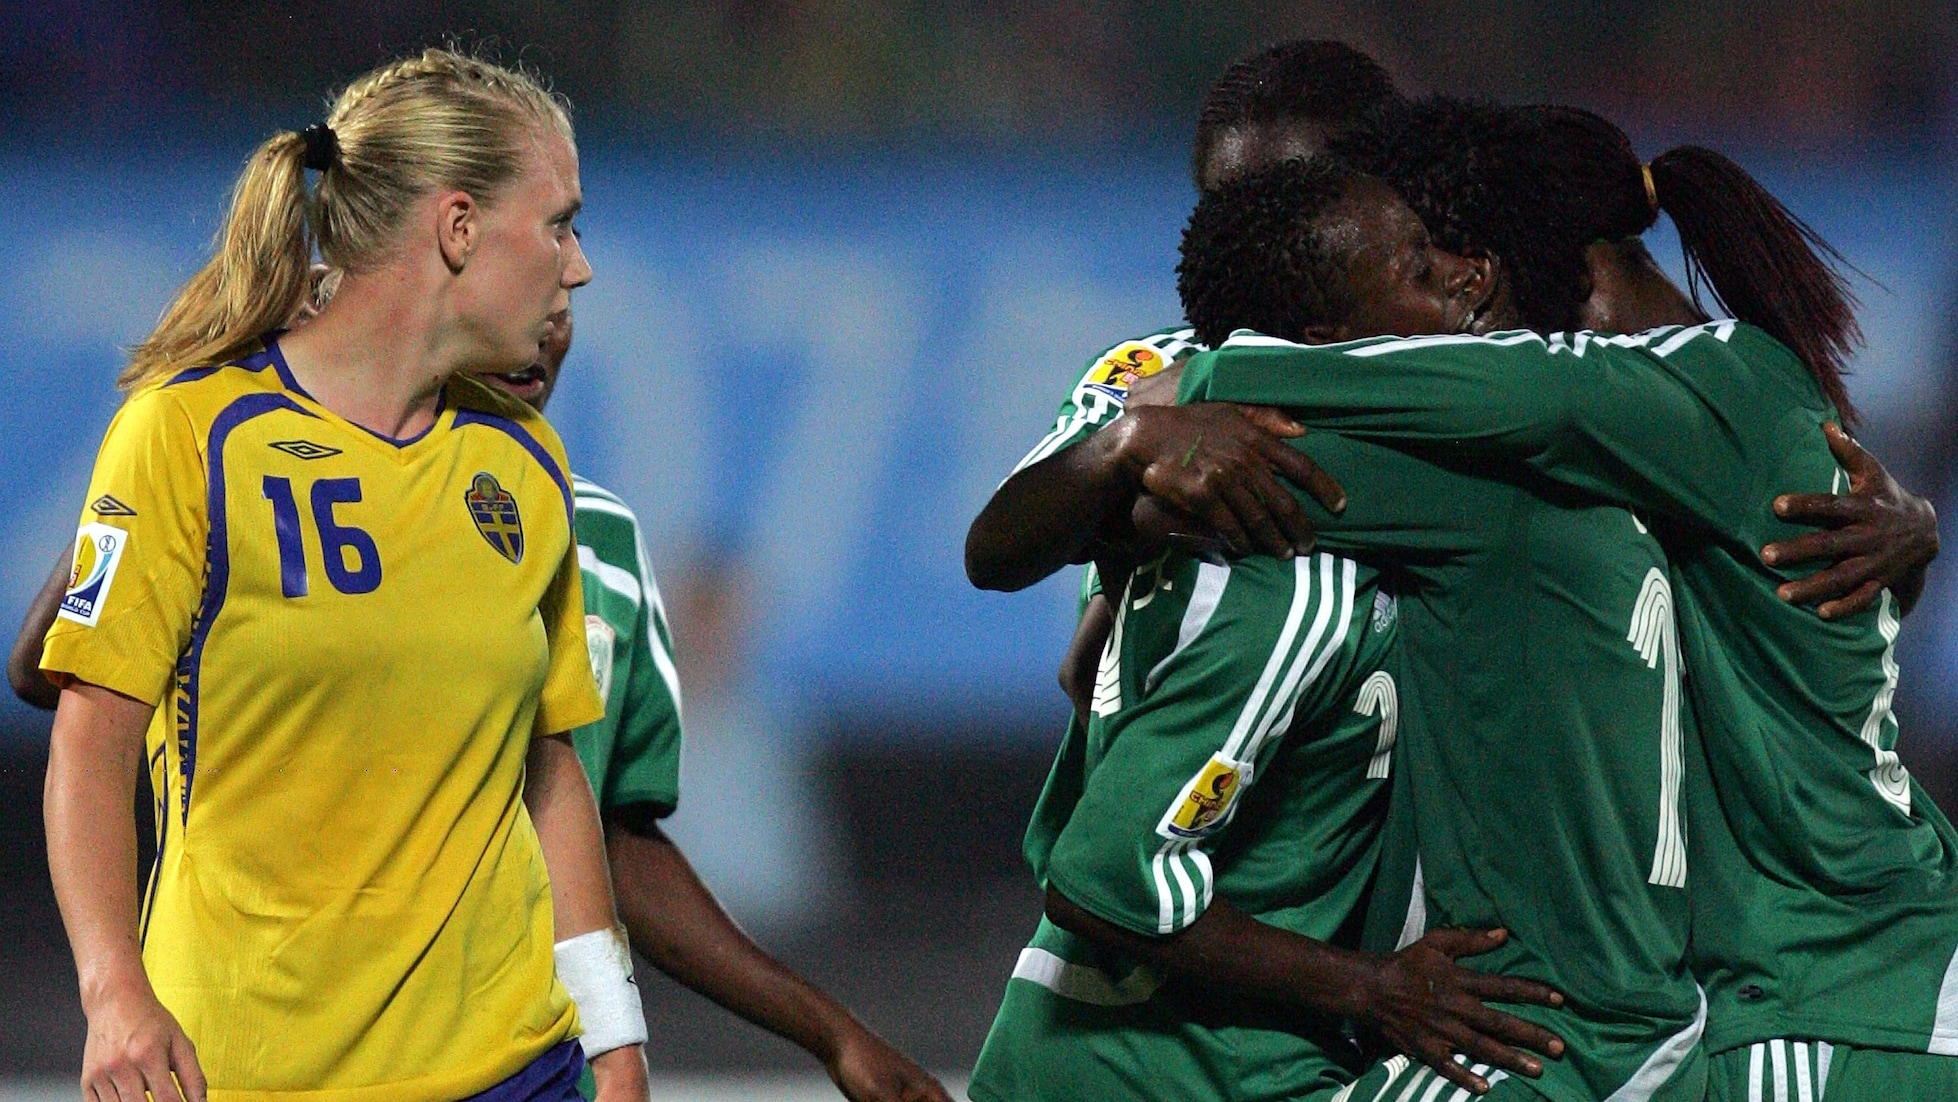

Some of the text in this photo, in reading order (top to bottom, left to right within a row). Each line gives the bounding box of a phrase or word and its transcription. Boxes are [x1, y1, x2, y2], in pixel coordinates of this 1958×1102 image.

[262, 474, 382, 598] 16
[67, 595, 92, 611] FIFA
[1626, 566, 1688, 888] 1
